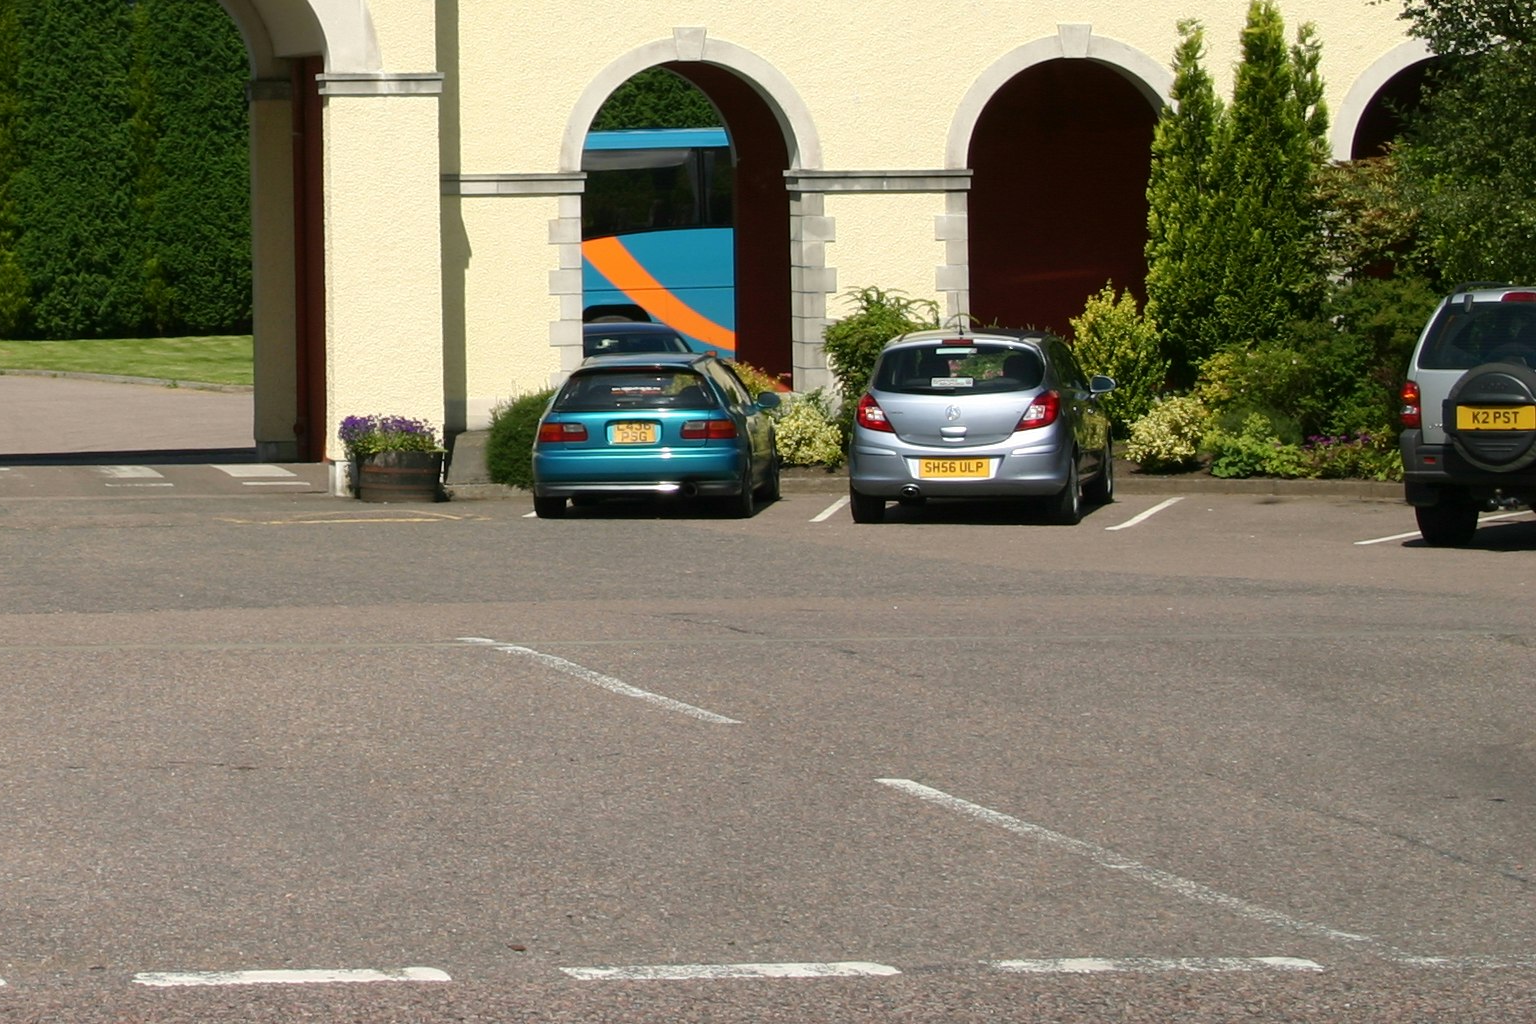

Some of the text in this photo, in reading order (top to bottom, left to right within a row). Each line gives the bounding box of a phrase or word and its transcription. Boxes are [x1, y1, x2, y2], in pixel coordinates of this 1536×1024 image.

[1472, 411, 1520, 424] K2 PST
[621, 431, 648, 442] PSG
[924, 461, 984, 474] SH56 ULP
